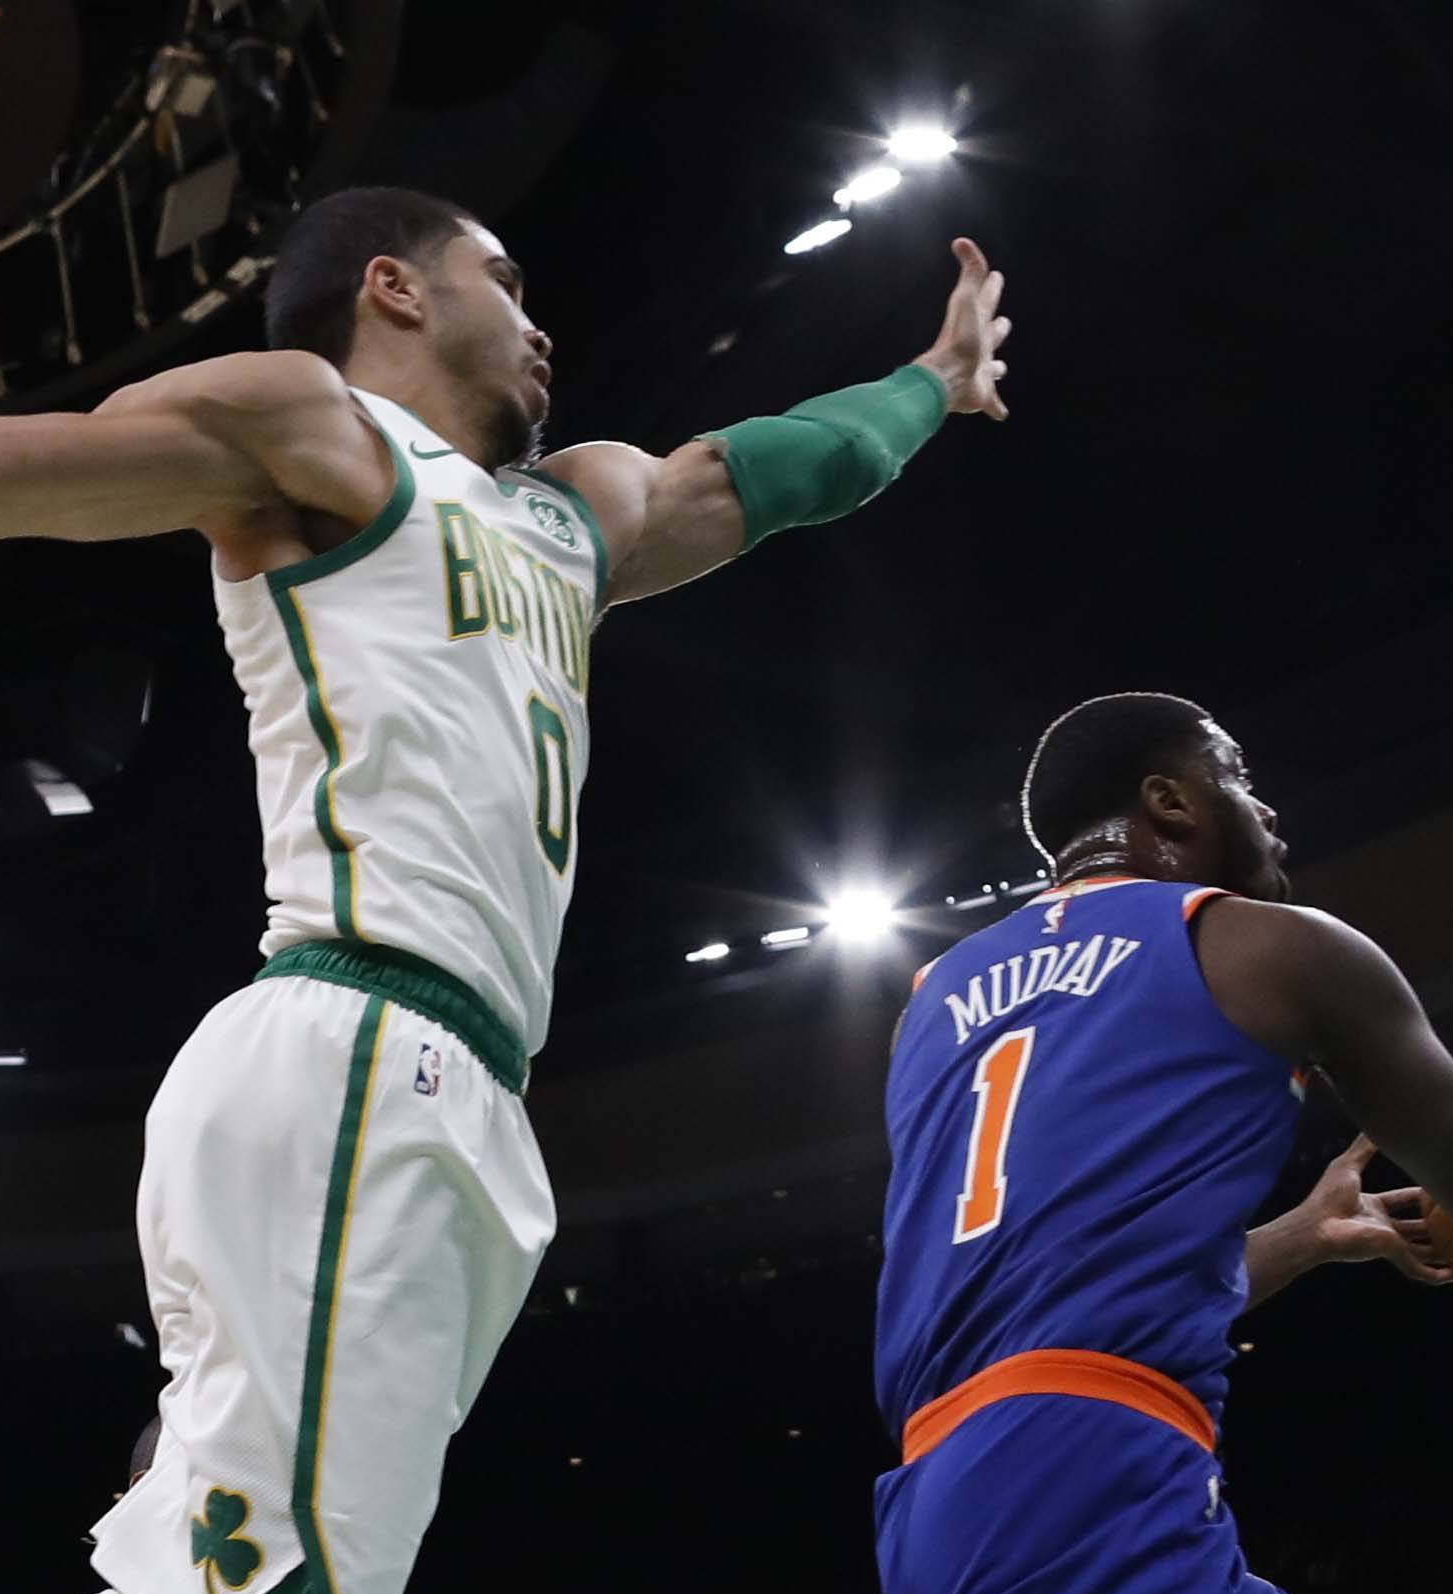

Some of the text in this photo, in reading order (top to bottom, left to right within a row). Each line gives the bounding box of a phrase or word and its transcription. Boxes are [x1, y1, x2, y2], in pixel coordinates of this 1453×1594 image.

[526, 689, 578, 877] 0
[945, 936, 1139, 1045] MUDIAY
[952, 1026, 1035, 1245] 1
